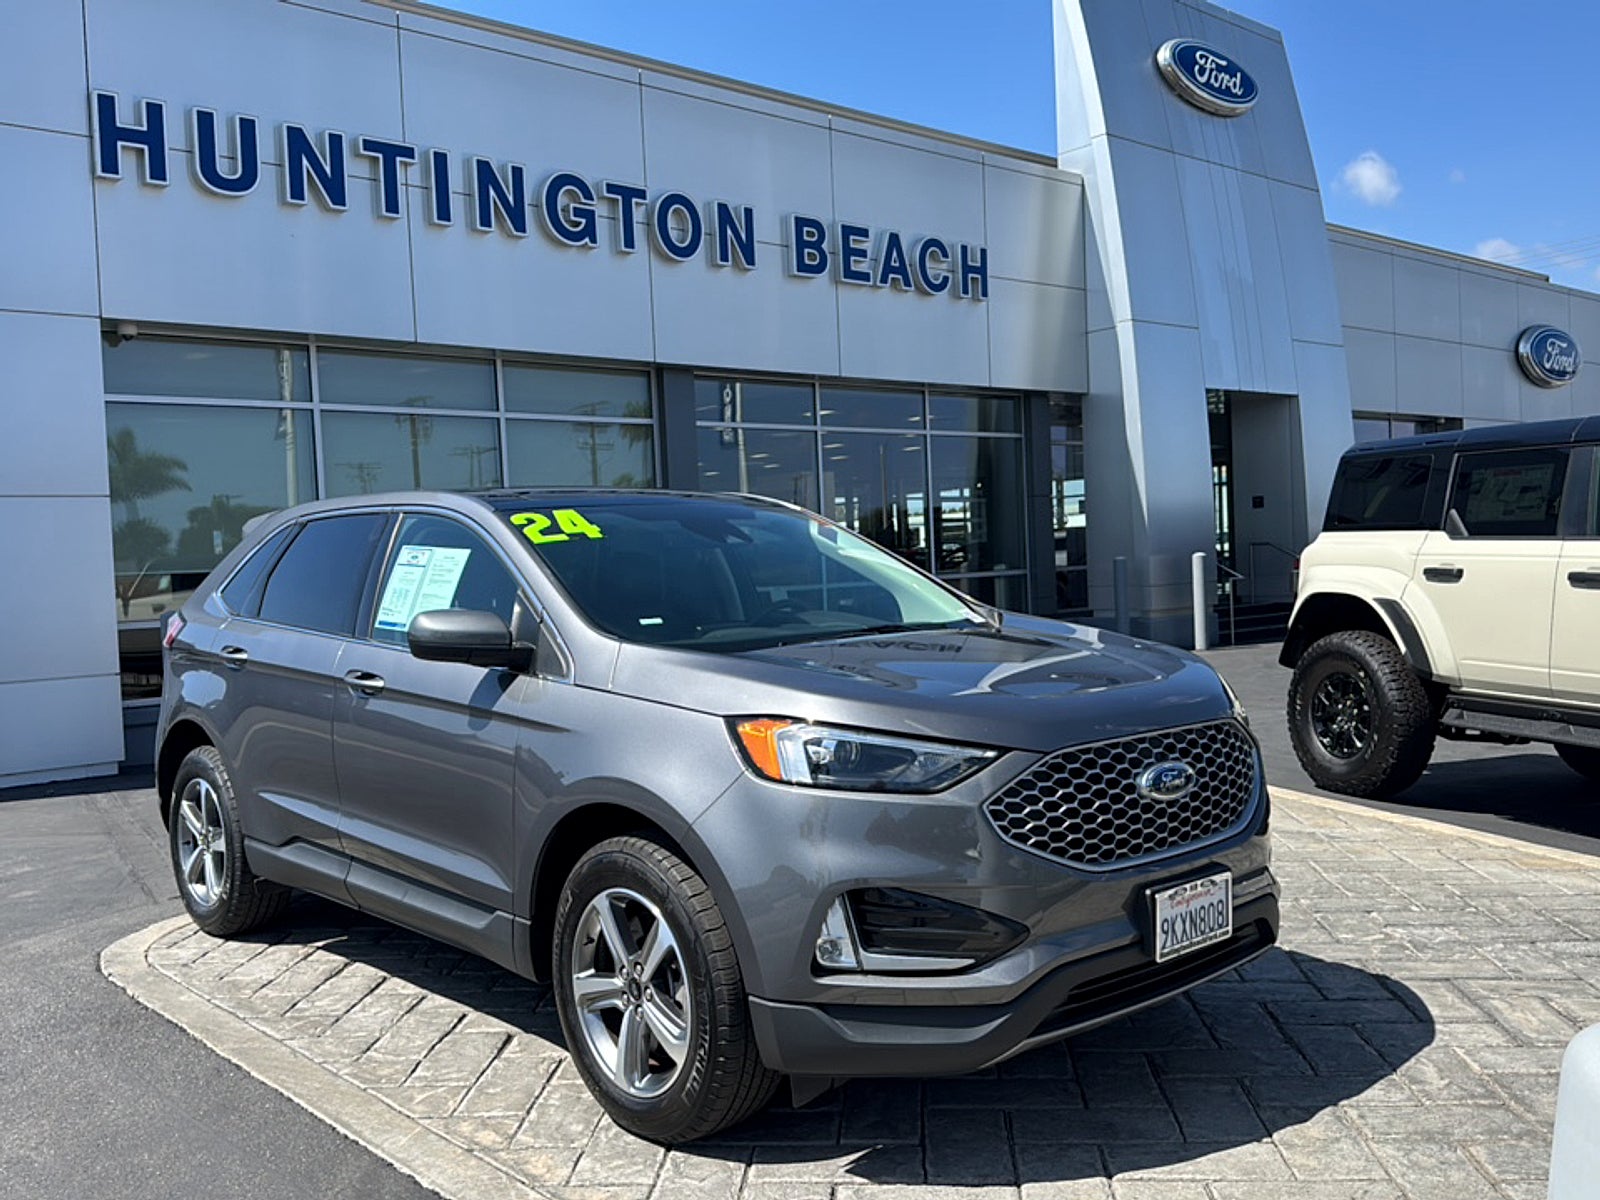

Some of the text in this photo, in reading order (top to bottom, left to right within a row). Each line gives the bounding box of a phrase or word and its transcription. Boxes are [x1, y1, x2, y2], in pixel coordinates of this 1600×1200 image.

[1193, 49, 1244, 97] Ford
[94, 90, 990, 300] HUNTINGTON BEACH
[1543, 337, 1576, 371] Ford
[509, 508, 604, 545] 24
[1160, 899, 1225, 952] 9KXN808
